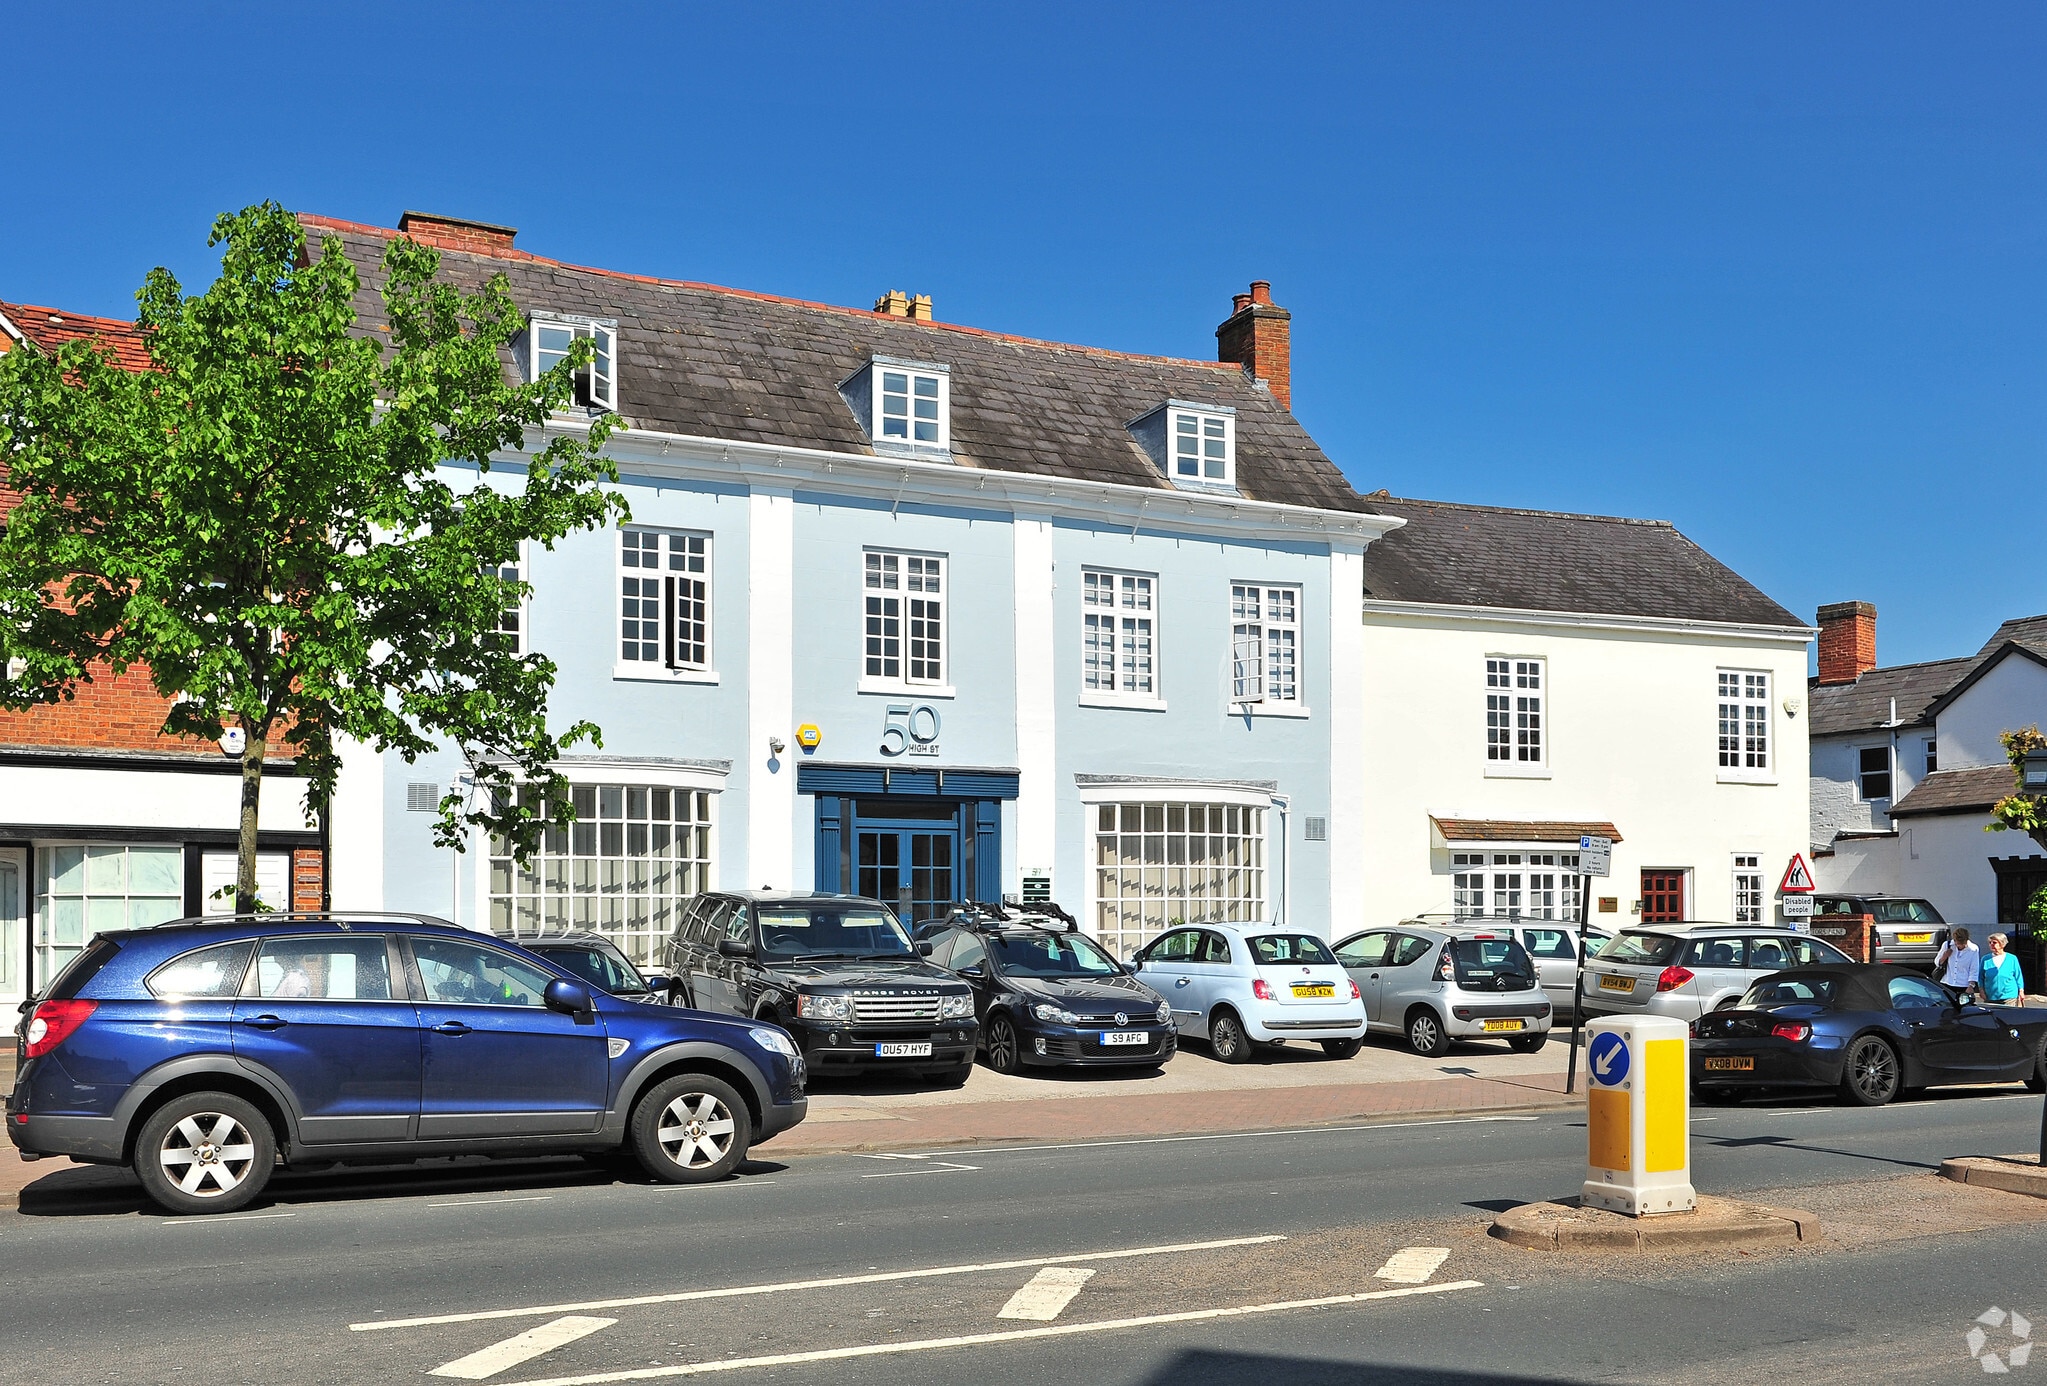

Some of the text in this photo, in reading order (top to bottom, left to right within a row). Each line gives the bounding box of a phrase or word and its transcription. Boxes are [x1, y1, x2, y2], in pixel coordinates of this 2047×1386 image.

[880, 703, 941, 757] 50
[909, 744, 940, 753] HIGH ST
[1296, 987, 1316, 996] GU58
[1112, 1033, 1142, 1042] S9 AFG
[882, 1044, 930, 1054] OU57 HYF
[1709, 1059, 1750, 1068] VX08 UVM
